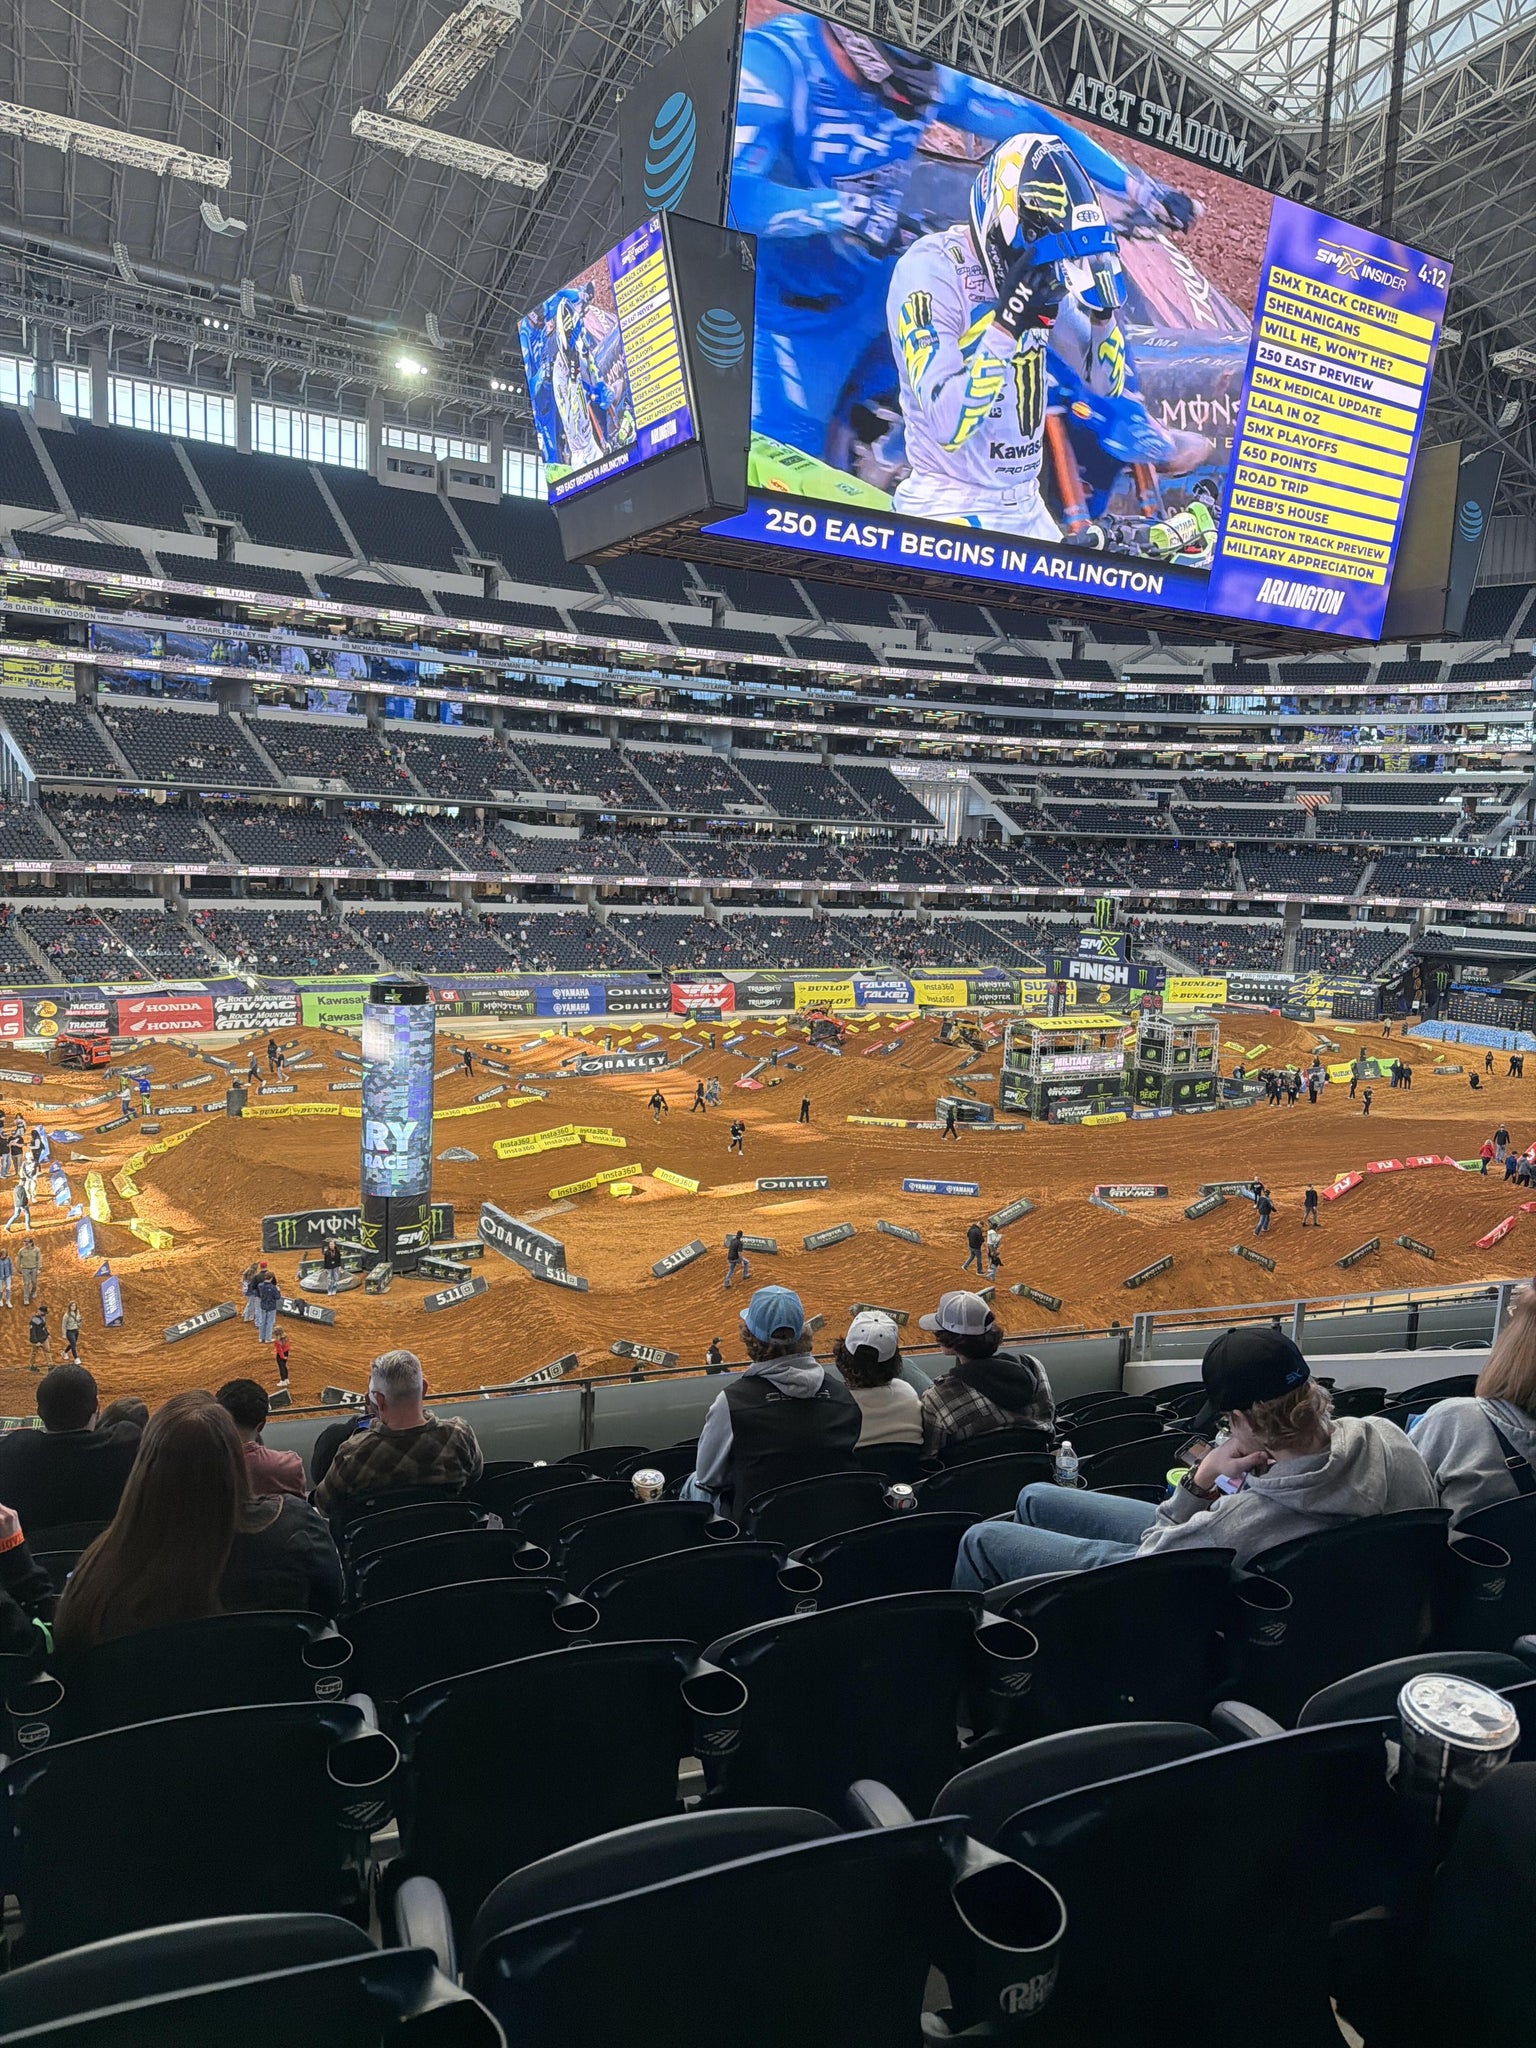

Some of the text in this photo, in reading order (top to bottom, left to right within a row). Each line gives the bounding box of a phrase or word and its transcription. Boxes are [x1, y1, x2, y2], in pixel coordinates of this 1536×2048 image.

[1066, 73, 1248, 172] AT&T STADIUM
[1315, 249, 1406, 291] SMX INSIDER
[1418, 264, 1446, 288] 4:12
[1002, 282, 1034, 326] FOX
[1272, 271, 1400, 325] SMX TRACK CREW!!!
[1269, 297, 1361, 338] SHENANIGANS
[1265, 321, 1394, 372] WILL HE, WON'T HE?
[1259, 347, 1375, 391] 250 EAST PREVIEW
[1256, 372, 1383, 419] SMX MEDICAL UPDATE
[1251, 397, 1321, 426] LALA IN OZ
[1247, 421, 1339, 455] SMX PLAYOFFS
[1243, 446, 1318, 475] 450 POINTS
[1239, 469, 1310, 496] ROAD TRIP
[1235, 495, 1330, 526] WEBB'S HOUSE
[1230, 518, 1386, 561] ARLINGTON TRACK PREVIEW
[765, 508, 1163, 595] 250 EAST BEGINS IN ARLINGTON
[19, 560, 65, 573] MILITARY
[1227, 541, 1376, 580] MILITARY APPRECIATION
[122, 574, 164, 587] MILITARY
[216, 588, 256, 599] MILITARY
[1257, 577, 1346, 617] ARLINGTON
[16, 605, 50, 613] DARREN
[54, 609, 96, 619] WOODSON
[305, 600, 343, 611] MILITARY
[197, 627, 231, 637] CHARLES
[233, 630, 256, 639] HALEY
[351, 644, 399, 655] MICHAEL IRVIN
[1079, 936, 1120, 956] SMX
[1069, 961, 1129, 985] FINISH
[561, 988, 590, 996] YAMAHA
[690, 984, 729, 994] FLY
[924, 983, 954, 991] Insta360
[146, 1003, 202, 1012] HONDA
[483, 1002, 523, 1010] MONSTER
[561, 1003, 590, 1011] YAMAHA
[624, 1002, 669, 1010] OAKLEY
[690, 999, 729, 1007] FLY
[147, 1021, 202, 1030] HONDA
[1049, 1018, 1114, 1026] DUNLOP
[602, 1056, 666, 1071] OAKLEY
[1054, 1056, 1093, 1067] MILITARY
[1004, 1089, 1028, 1105] SMX
[366, 1120, 418, 1151] RY
[539, 1127, 569, 1138] Insta360
[592, 1134, 621, 1143] Insta360
[500, 1138, 531, 1149] Insta360
[543, 1136, 575, 1146] Insta360
[503, 1145, 535, 1155] Insta360
[364, 1155, 408, 1170] RACE
[1377, 1161, 1394, 1169] FLY
[1417, 1157, 1433, 1165] FLY
[602, 1166, 636, 1179] Insta360
[660, 1170, 693, 1188] Insta360
[557, 1181, 592, 1196] Insta360
[778, 1179, 828, 1188] OAKLEY
[914, 1182, 937, 1191] YAMAHA
[952, 1185, 974, 1193] YAMAHA
[1333, 1177, 1351, 1194] FLY
[1493, 1225, 1510, 1241] FLY
[496, 1226, 552, 1266] OAKLEY
[661, 1249, 685, 1269] 5.11
[546, 1268, 566, 1284] 5.11
[436, 1288, 461, 1306] 5.11
[178, 1315, 207, 1334] 5.11
[632, 1344, 653, 1361] 5.11
[315, 1683, 342, 1693] PEPSI
